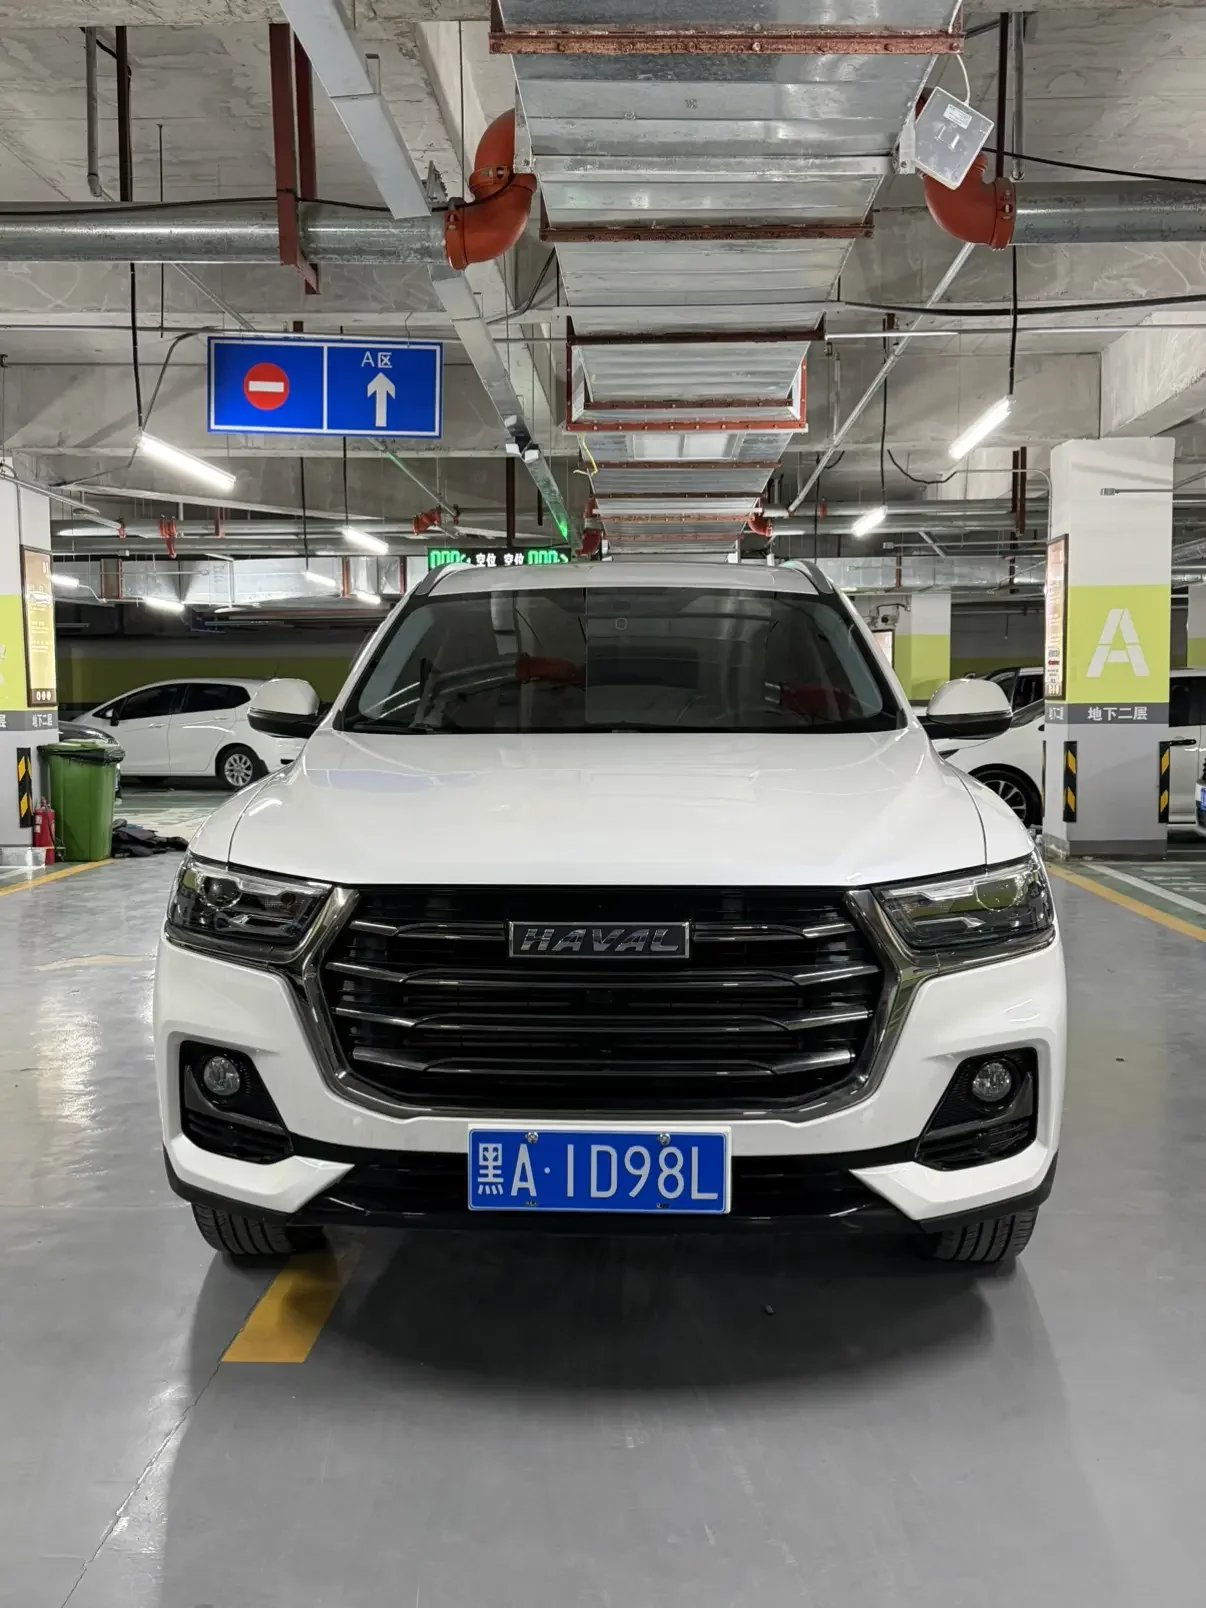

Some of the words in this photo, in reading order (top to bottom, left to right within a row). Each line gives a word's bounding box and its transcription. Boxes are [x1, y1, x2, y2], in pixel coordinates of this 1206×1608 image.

[361, 351, 392, 368] A区
[475, 552, 497, 567] 空位
[1086, 608, 1150, 678] A
[1087, 706, 1148, 721] 地下二层
[520, 928, 679, 951] HAVAL
[477, 1143, 718, 1200] 黑A·1D98L
